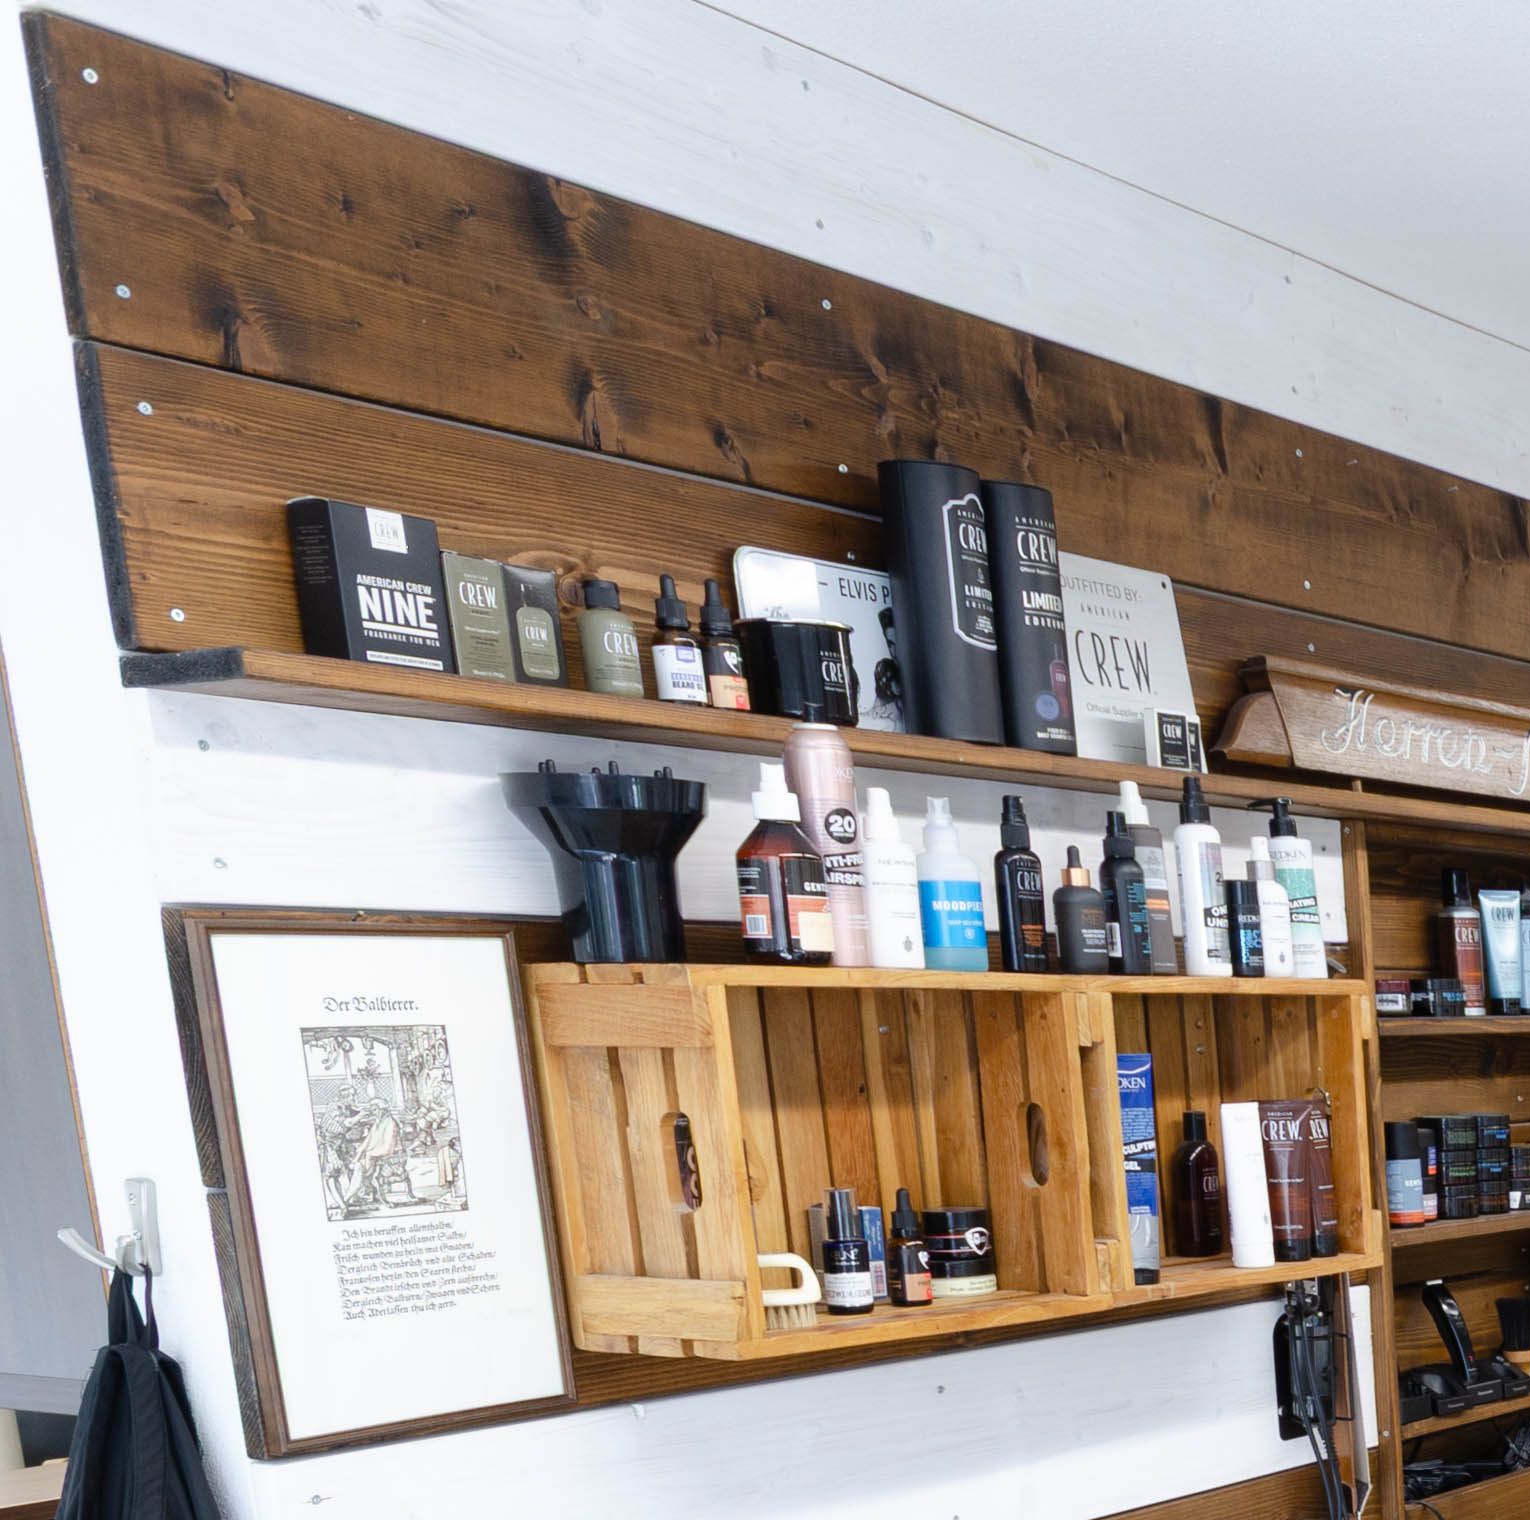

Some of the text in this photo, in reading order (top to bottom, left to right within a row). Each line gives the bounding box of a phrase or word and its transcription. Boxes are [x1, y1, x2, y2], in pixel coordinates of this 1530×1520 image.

[356, 574, 432, 595] AMERICAN CREW
[460, 582, 497, 608] CREW
[838, 578, 877, 602] ELVIS
[1060, 574, 1122, 600] OUTFITTED
[357, 585, 438, 630] NINE
[1080, 604, 1130, 622] AMERICAN
[526, 626, 548, 641] CREW
[1075, 630, 1151, 694] CREW
[1163, 722, 1182, 739] CREW
[828, 815, 856, 833] 20
[322, 996, 418, 1012] Der Balbierer.
[1262, 1120, 1300, 1141] CREW
